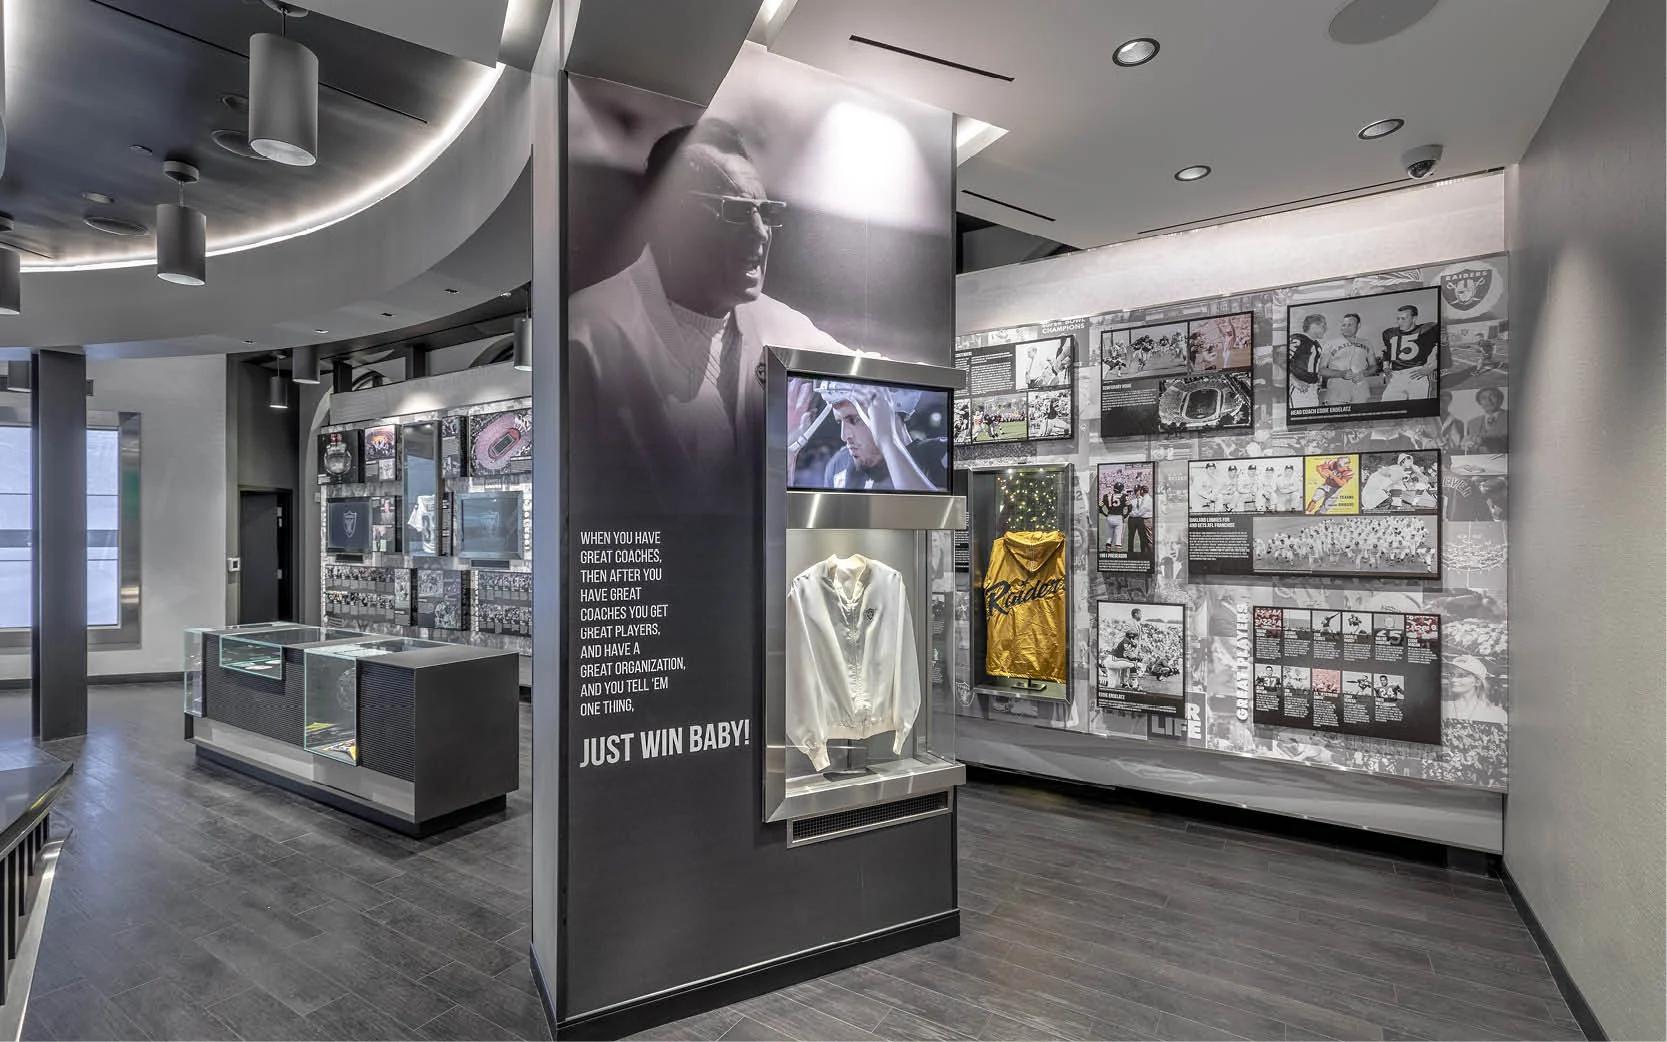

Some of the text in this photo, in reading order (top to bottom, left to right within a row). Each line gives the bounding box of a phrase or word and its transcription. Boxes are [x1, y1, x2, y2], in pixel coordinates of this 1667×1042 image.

[1445, 271, 1488, 281] RAIDERS
[1042, 323, 1085, 334] CHAMPIONS
[1390, 333, 1419, 360] 15
[1107, 493, 1121, 507] 15
[581, 531, 660, 545] WHEN YOU HAVE
[580, 549, 662, 564] GREAT COACHES,
[580, 568, 662, 583] THEN AFTER YOU
[580, 587, 642, 602] HAVE GREAT
[580, 604, 668, 621] COACHES YOU GET
[580, 623, 661, 639] GREAT PLAYERS,
[580, 642, 640, 659] AND HAVE A
[580, 657, 686, 678] GREAT ORGANIZATION,
[1236, 602, 1249, 720] GREAT PLAYERS
[580, 677, 669, 697] AND YOU TELL 'EM
[580, 698, 635, 716] ONE THING,
[580, 719, 750, 768] JUST WIN BABY!
